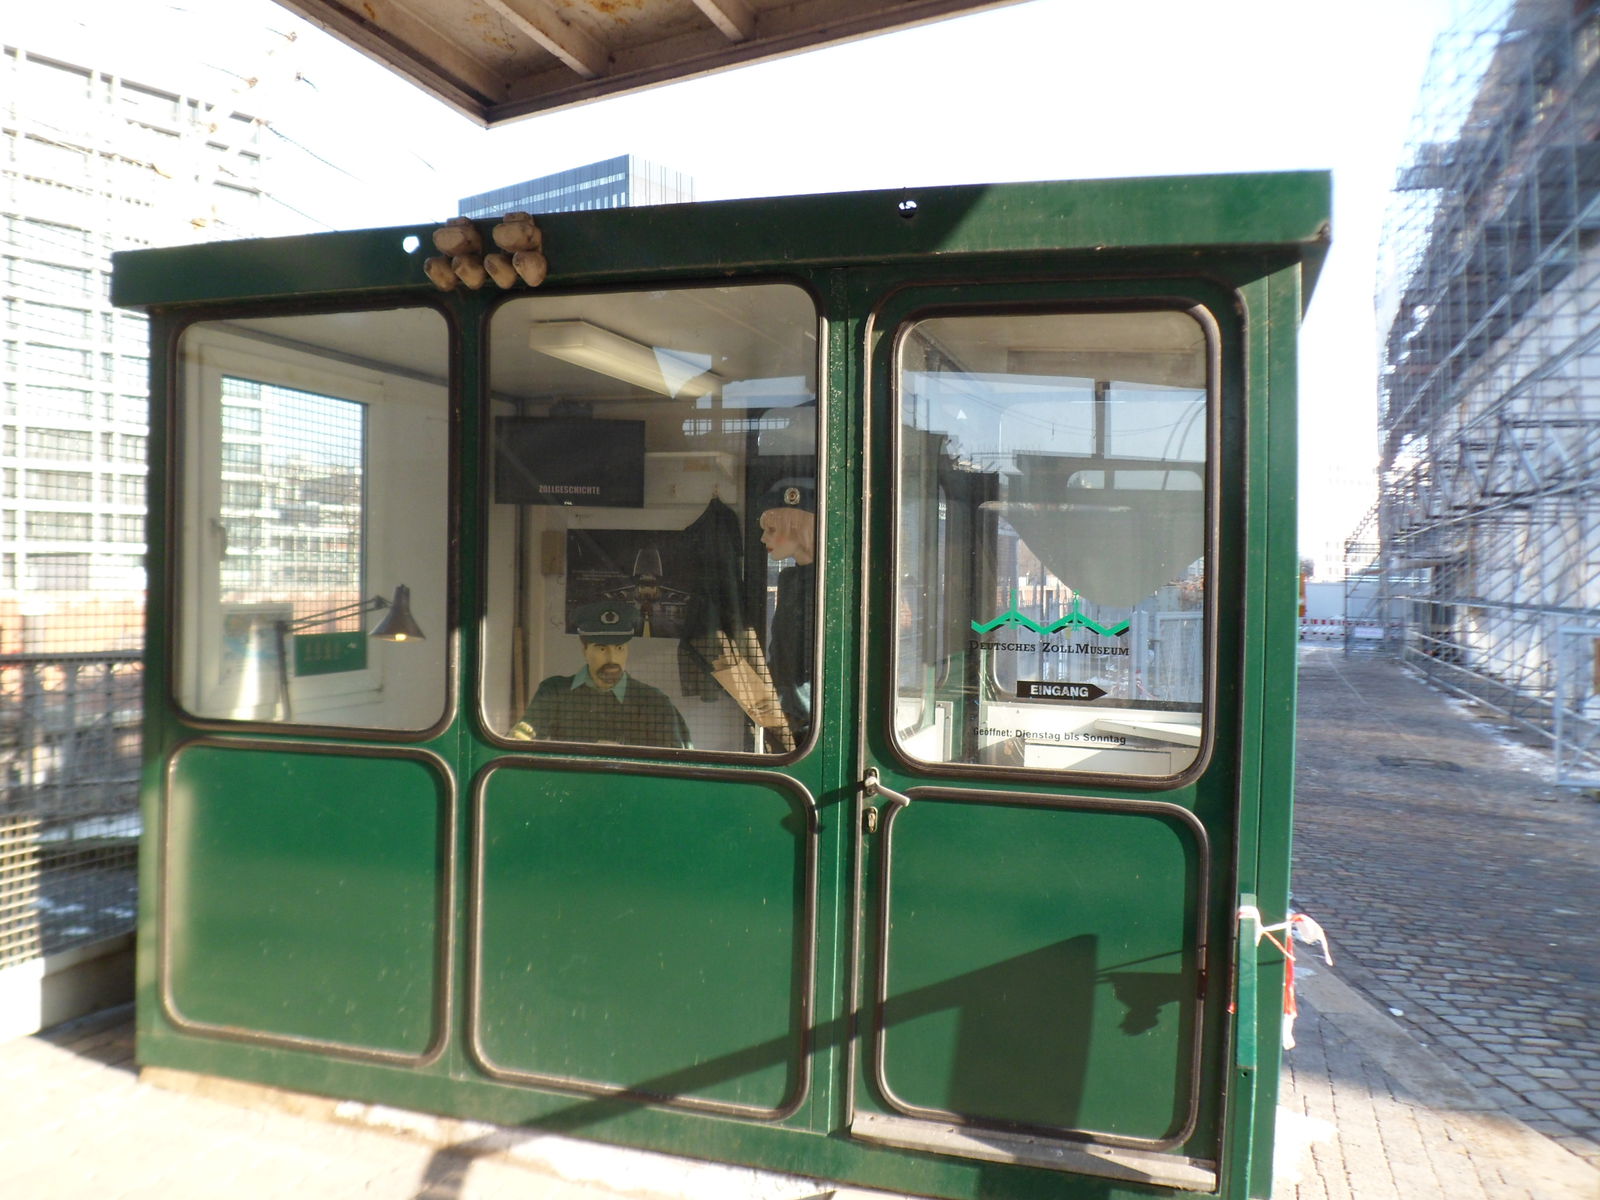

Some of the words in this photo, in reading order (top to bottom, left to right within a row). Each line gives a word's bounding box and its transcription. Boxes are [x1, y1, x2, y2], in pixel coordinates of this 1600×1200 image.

[969, 640, 1036, 652] DEUTSCHES
[1030, 684, 1089, 697] EINGANG
[1015, 729, 1061, 741] Dienstag
[1063, 732, 1080, 741] bis
[1083, 733, 1126, 744] Sonntag
